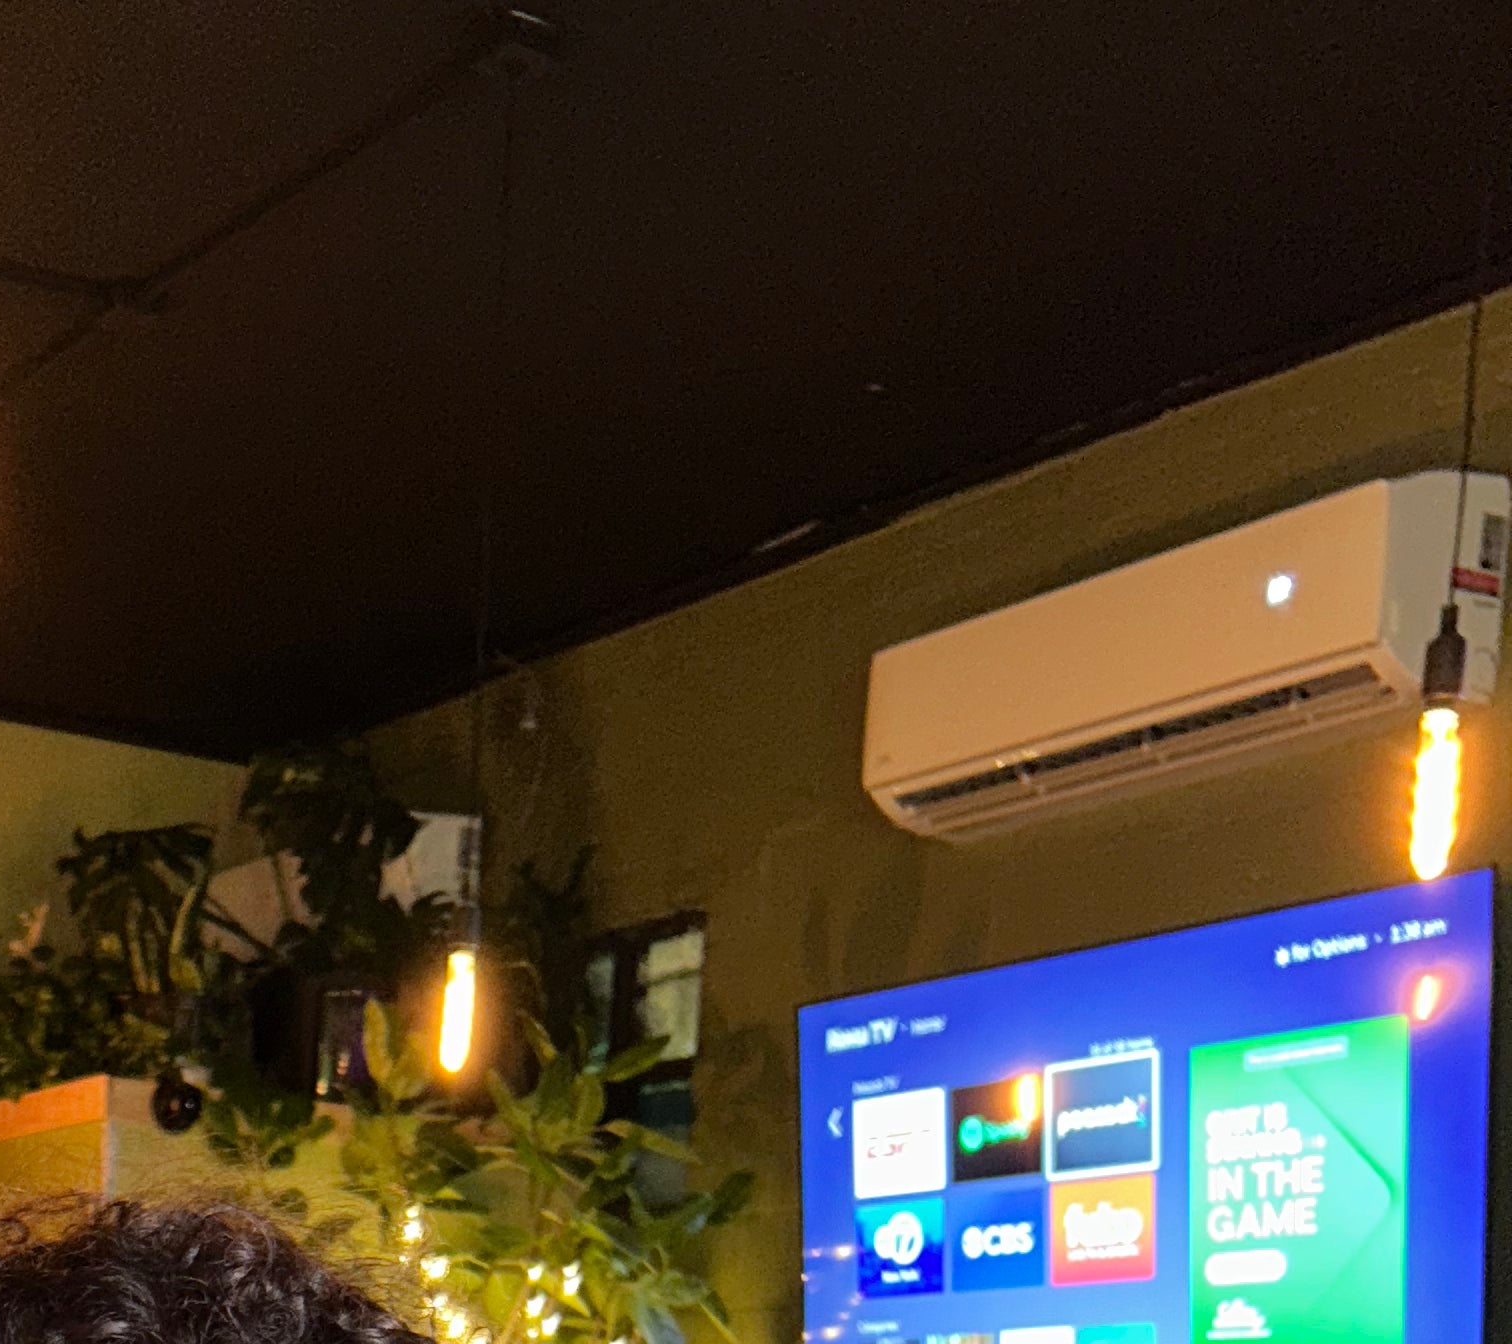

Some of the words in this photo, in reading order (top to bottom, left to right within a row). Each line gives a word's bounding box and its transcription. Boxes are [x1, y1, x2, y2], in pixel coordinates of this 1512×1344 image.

[1208, 1164, 1244, 1203] IN
[1250, 1155, 1325, 1198] THE
[983, 1222, 1035, 1257] CBS
[1207, 1196, 1318, 1242] GAME
